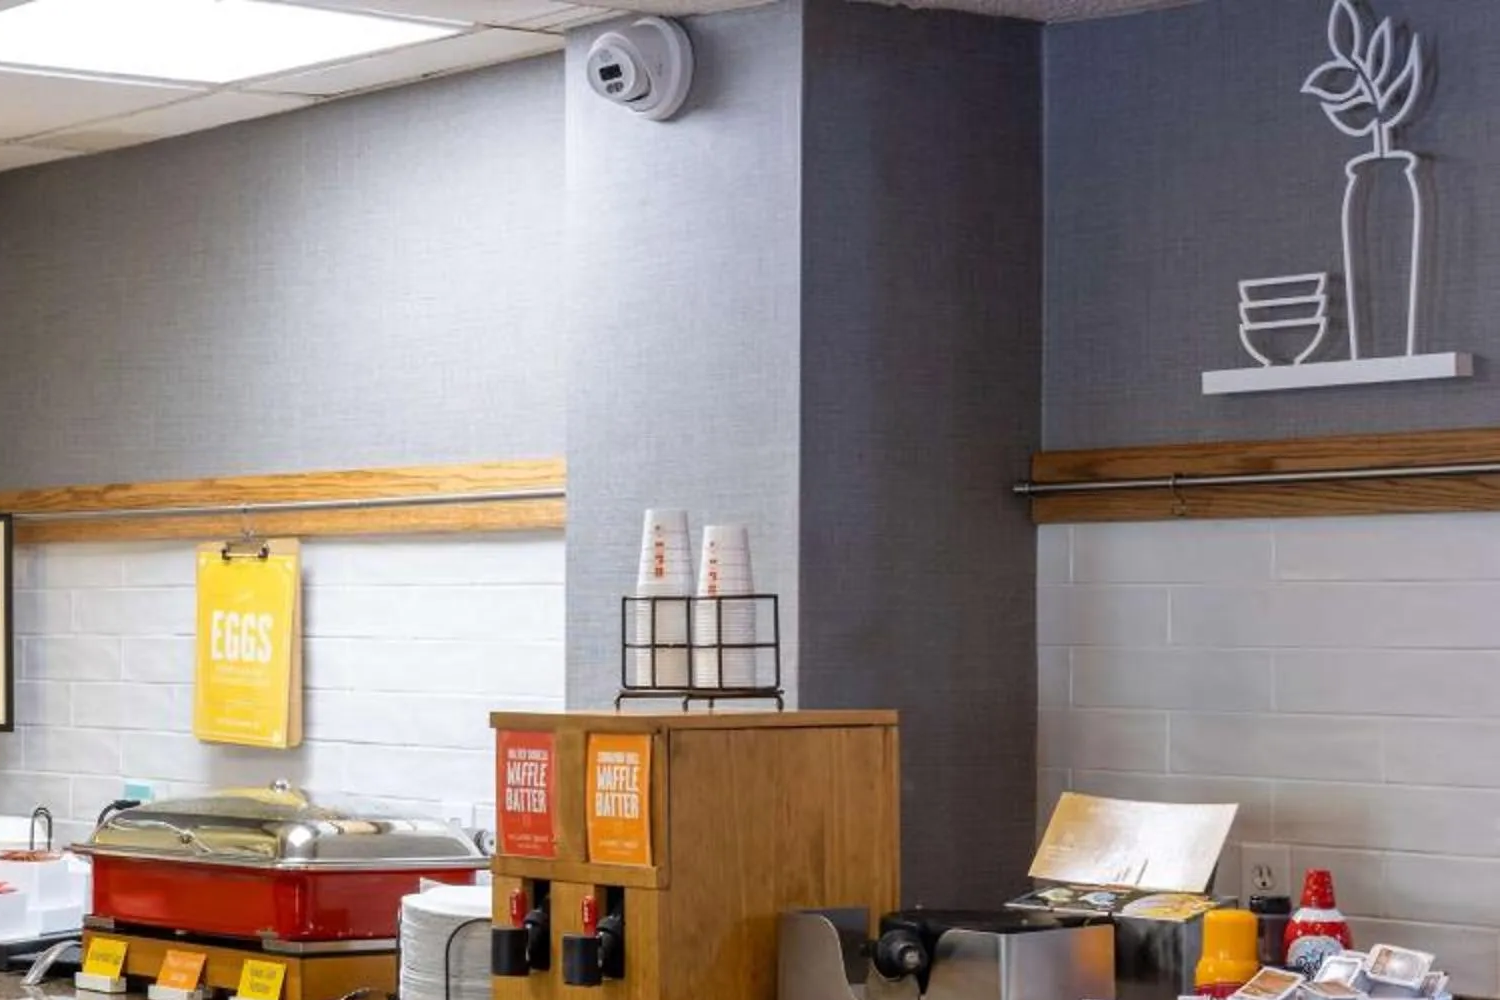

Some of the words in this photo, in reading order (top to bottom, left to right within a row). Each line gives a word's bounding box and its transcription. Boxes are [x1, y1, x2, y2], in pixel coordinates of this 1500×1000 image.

[211, 609, 274, 664] EGGS
[506, 761, 549, 787] WAFFLE
[596, 764, 640, 792] WAFFLE
[505, 787, 548, 814] BATTER
[595, 792, 639, 819] BATTER
